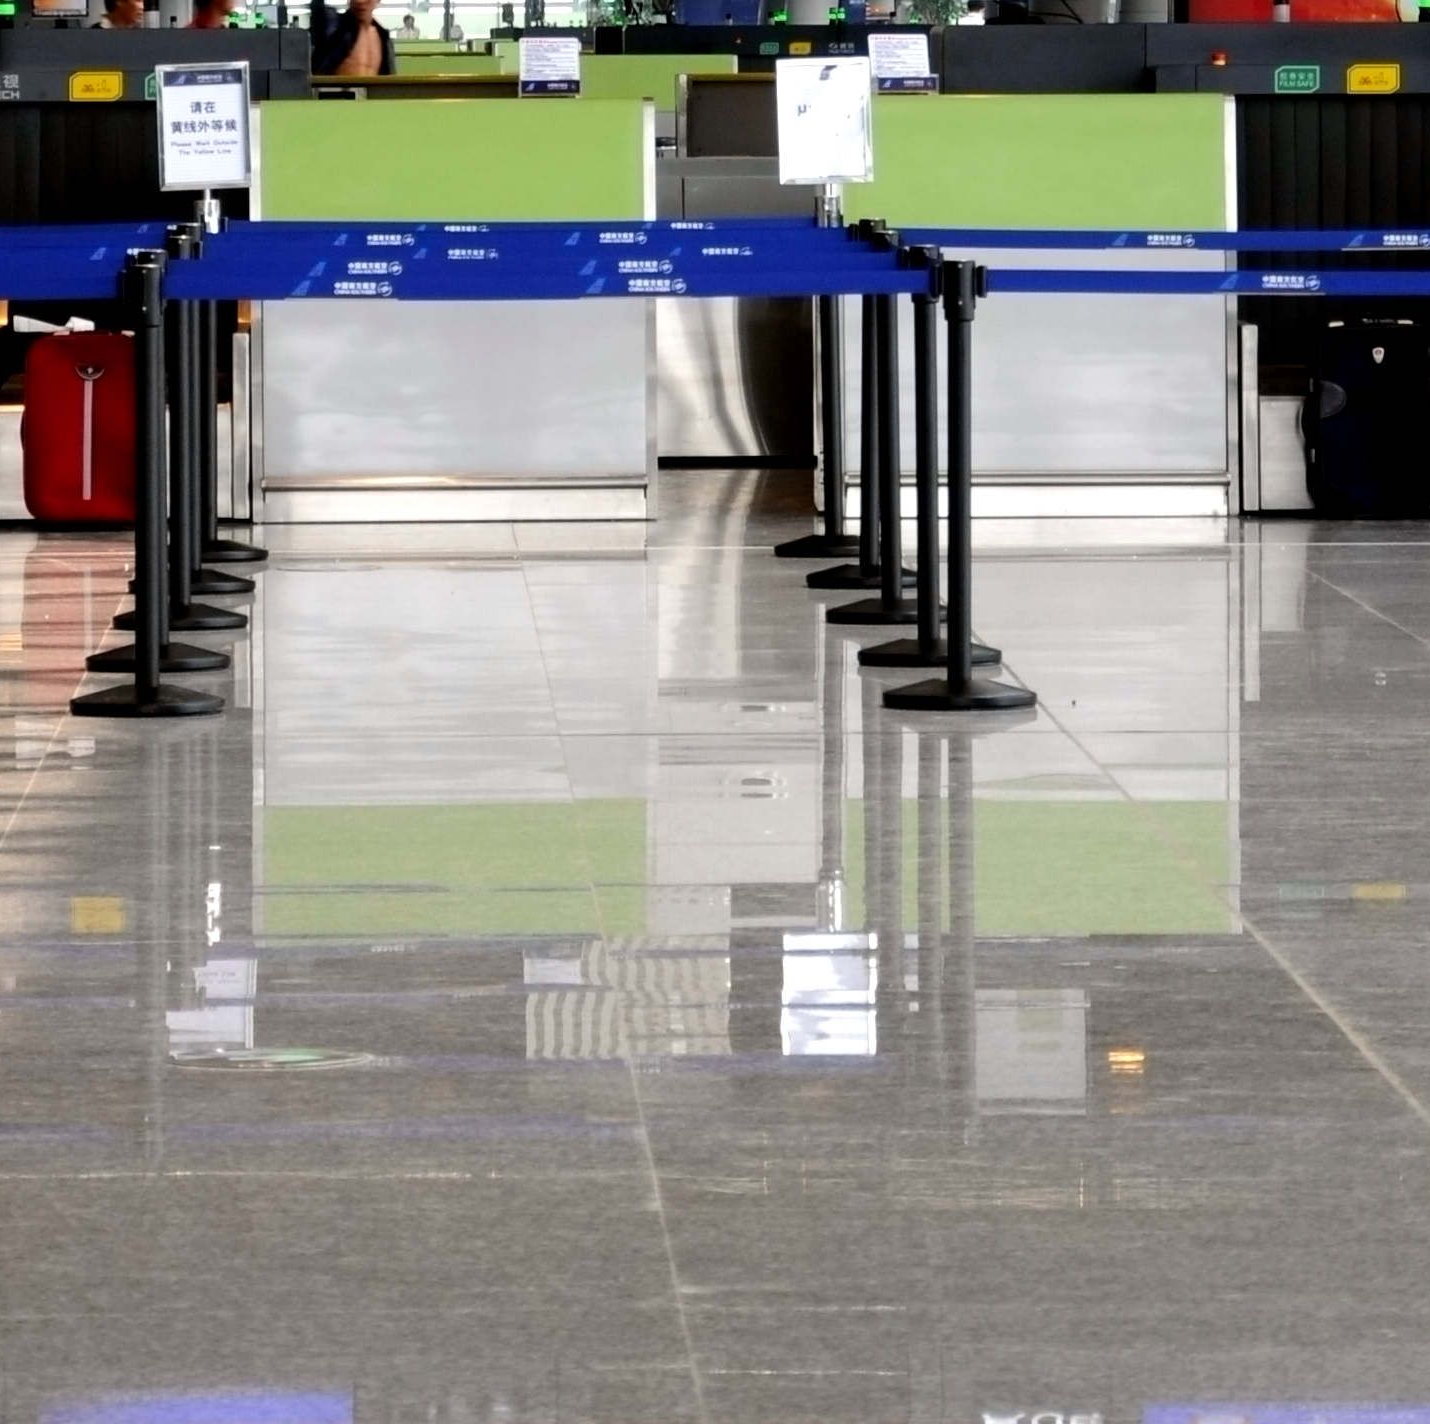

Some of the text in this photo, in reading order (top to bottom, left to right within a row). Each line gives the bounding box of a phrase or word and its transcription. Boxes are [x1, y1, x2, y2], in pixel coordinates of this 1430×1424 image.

[191, 101, 215, 113] 请在
[171, 119, 236, 133] 黄线外等候
